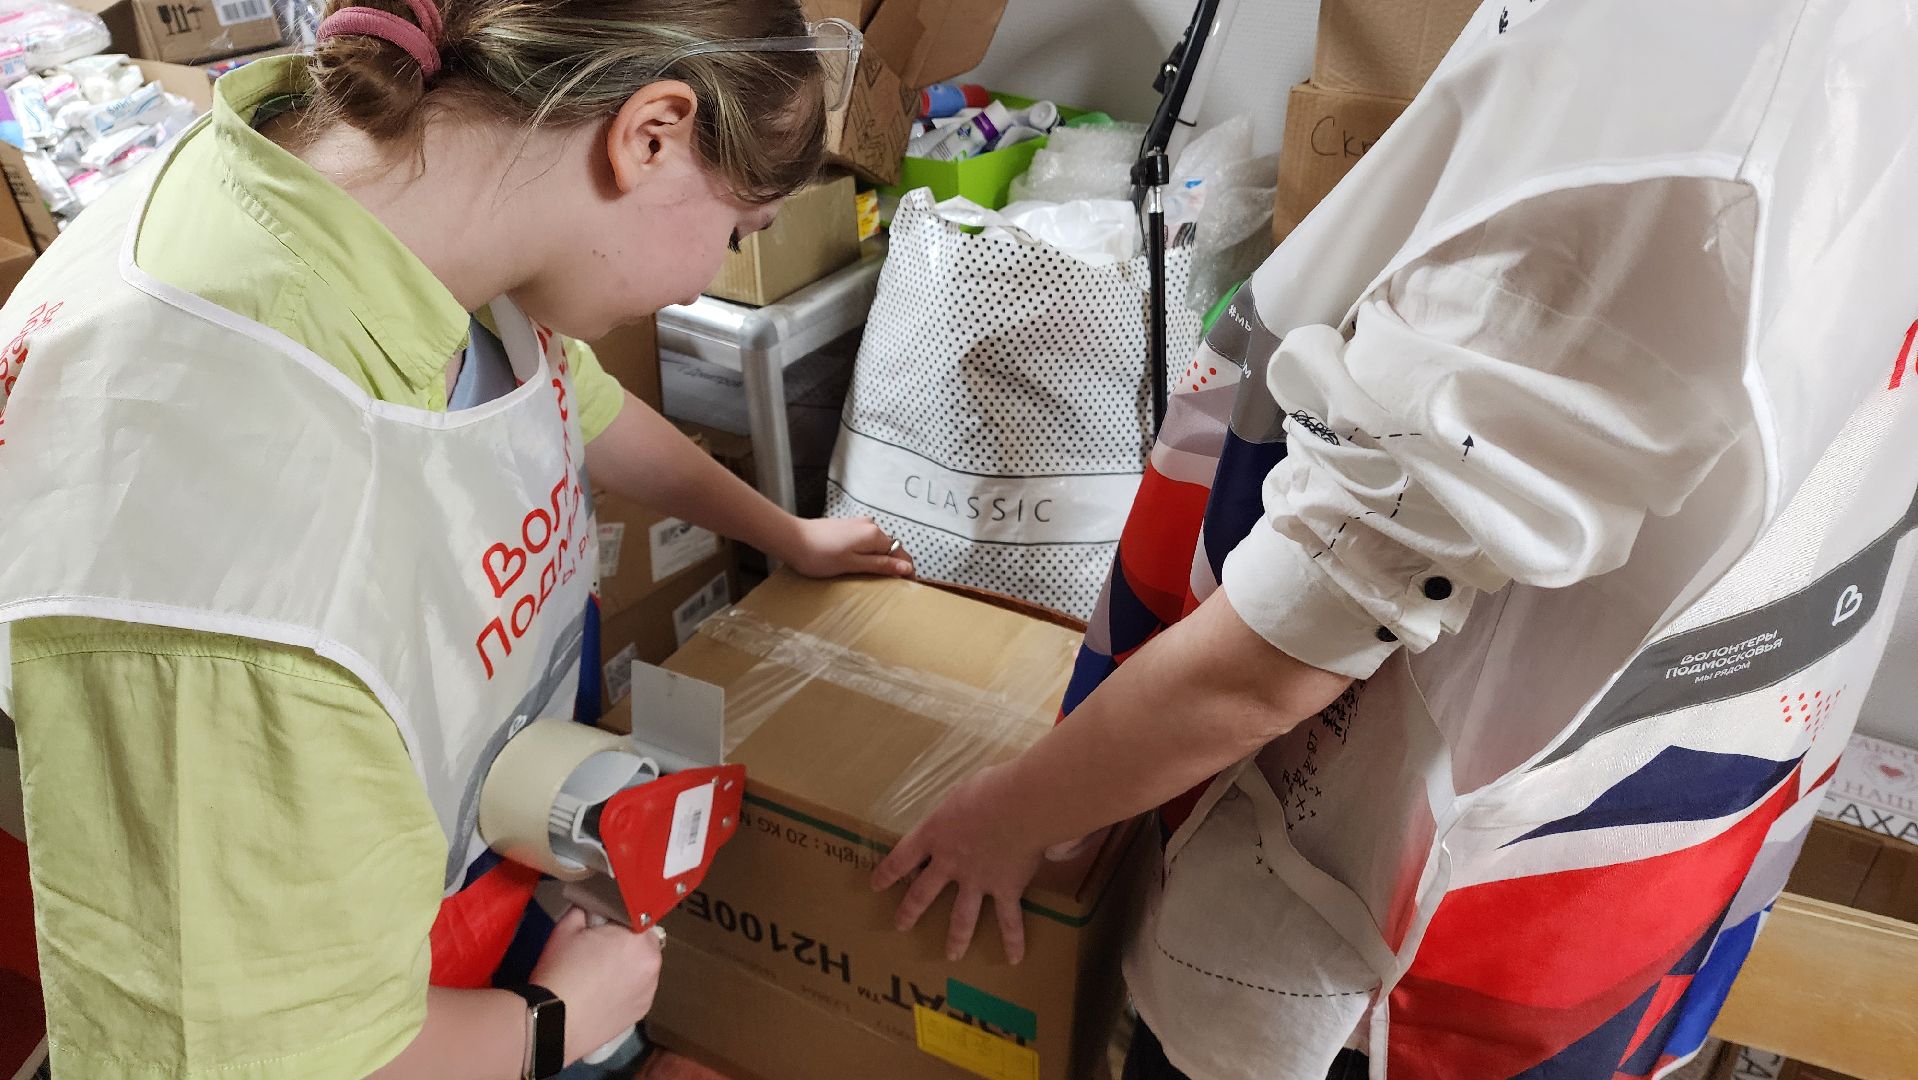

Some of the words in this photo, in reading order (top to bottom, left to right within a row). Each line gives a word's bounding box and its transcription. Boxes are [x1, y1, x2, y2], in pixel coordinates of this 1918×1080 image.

[904, 475, 1052, 523] CLASSIC
[1665, 637, 1784, 679] ПОДМОСКОВЬЯ
[1679, 629, 1779, 666] ВОЛОНТЕРЫ
[1694, 671, 1713, 683] МЫ
[1713, 660, 1752, 679] РЯДОМ
[757, 816, 781, 839] KG
[786, 827, 808, 848] 20
[676, 888, 851, 984] H2100E
